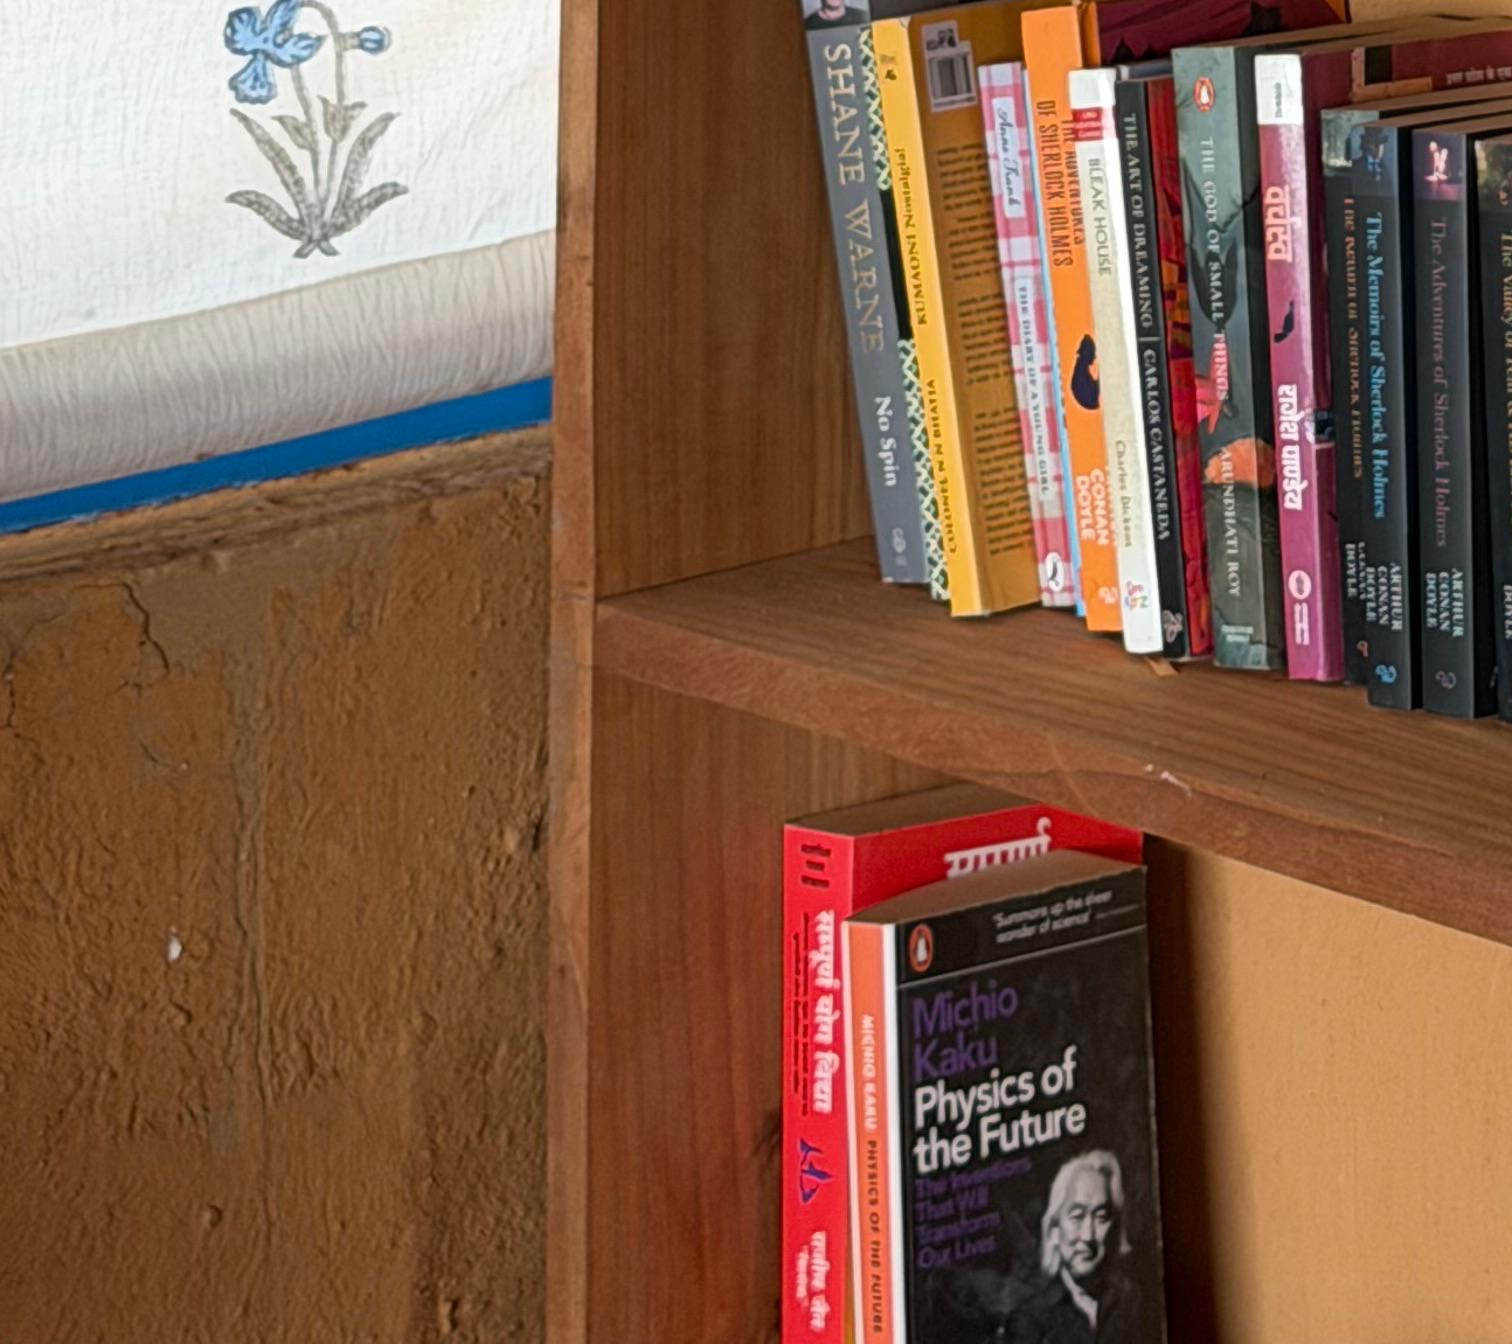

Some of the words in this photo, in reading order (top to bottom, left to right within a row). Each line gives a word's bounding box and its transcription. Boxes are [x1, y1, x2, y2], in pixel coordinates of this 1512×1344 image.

[823, 44, 865, 186] SHANE
[844, 198, 887, 354] WARNE
[1075, 475, 1095, 541] DOYLE
[911, 982, 1019, 1039] Michio
[911, 1036, 997, 1083] Kaku
[913, 1068, 1035, 1132] Physics
[1041, 1046, 1078, 1095] of
[913, 1129, 971, 1174] the
[979, 1098, 1087, 1159] Future
